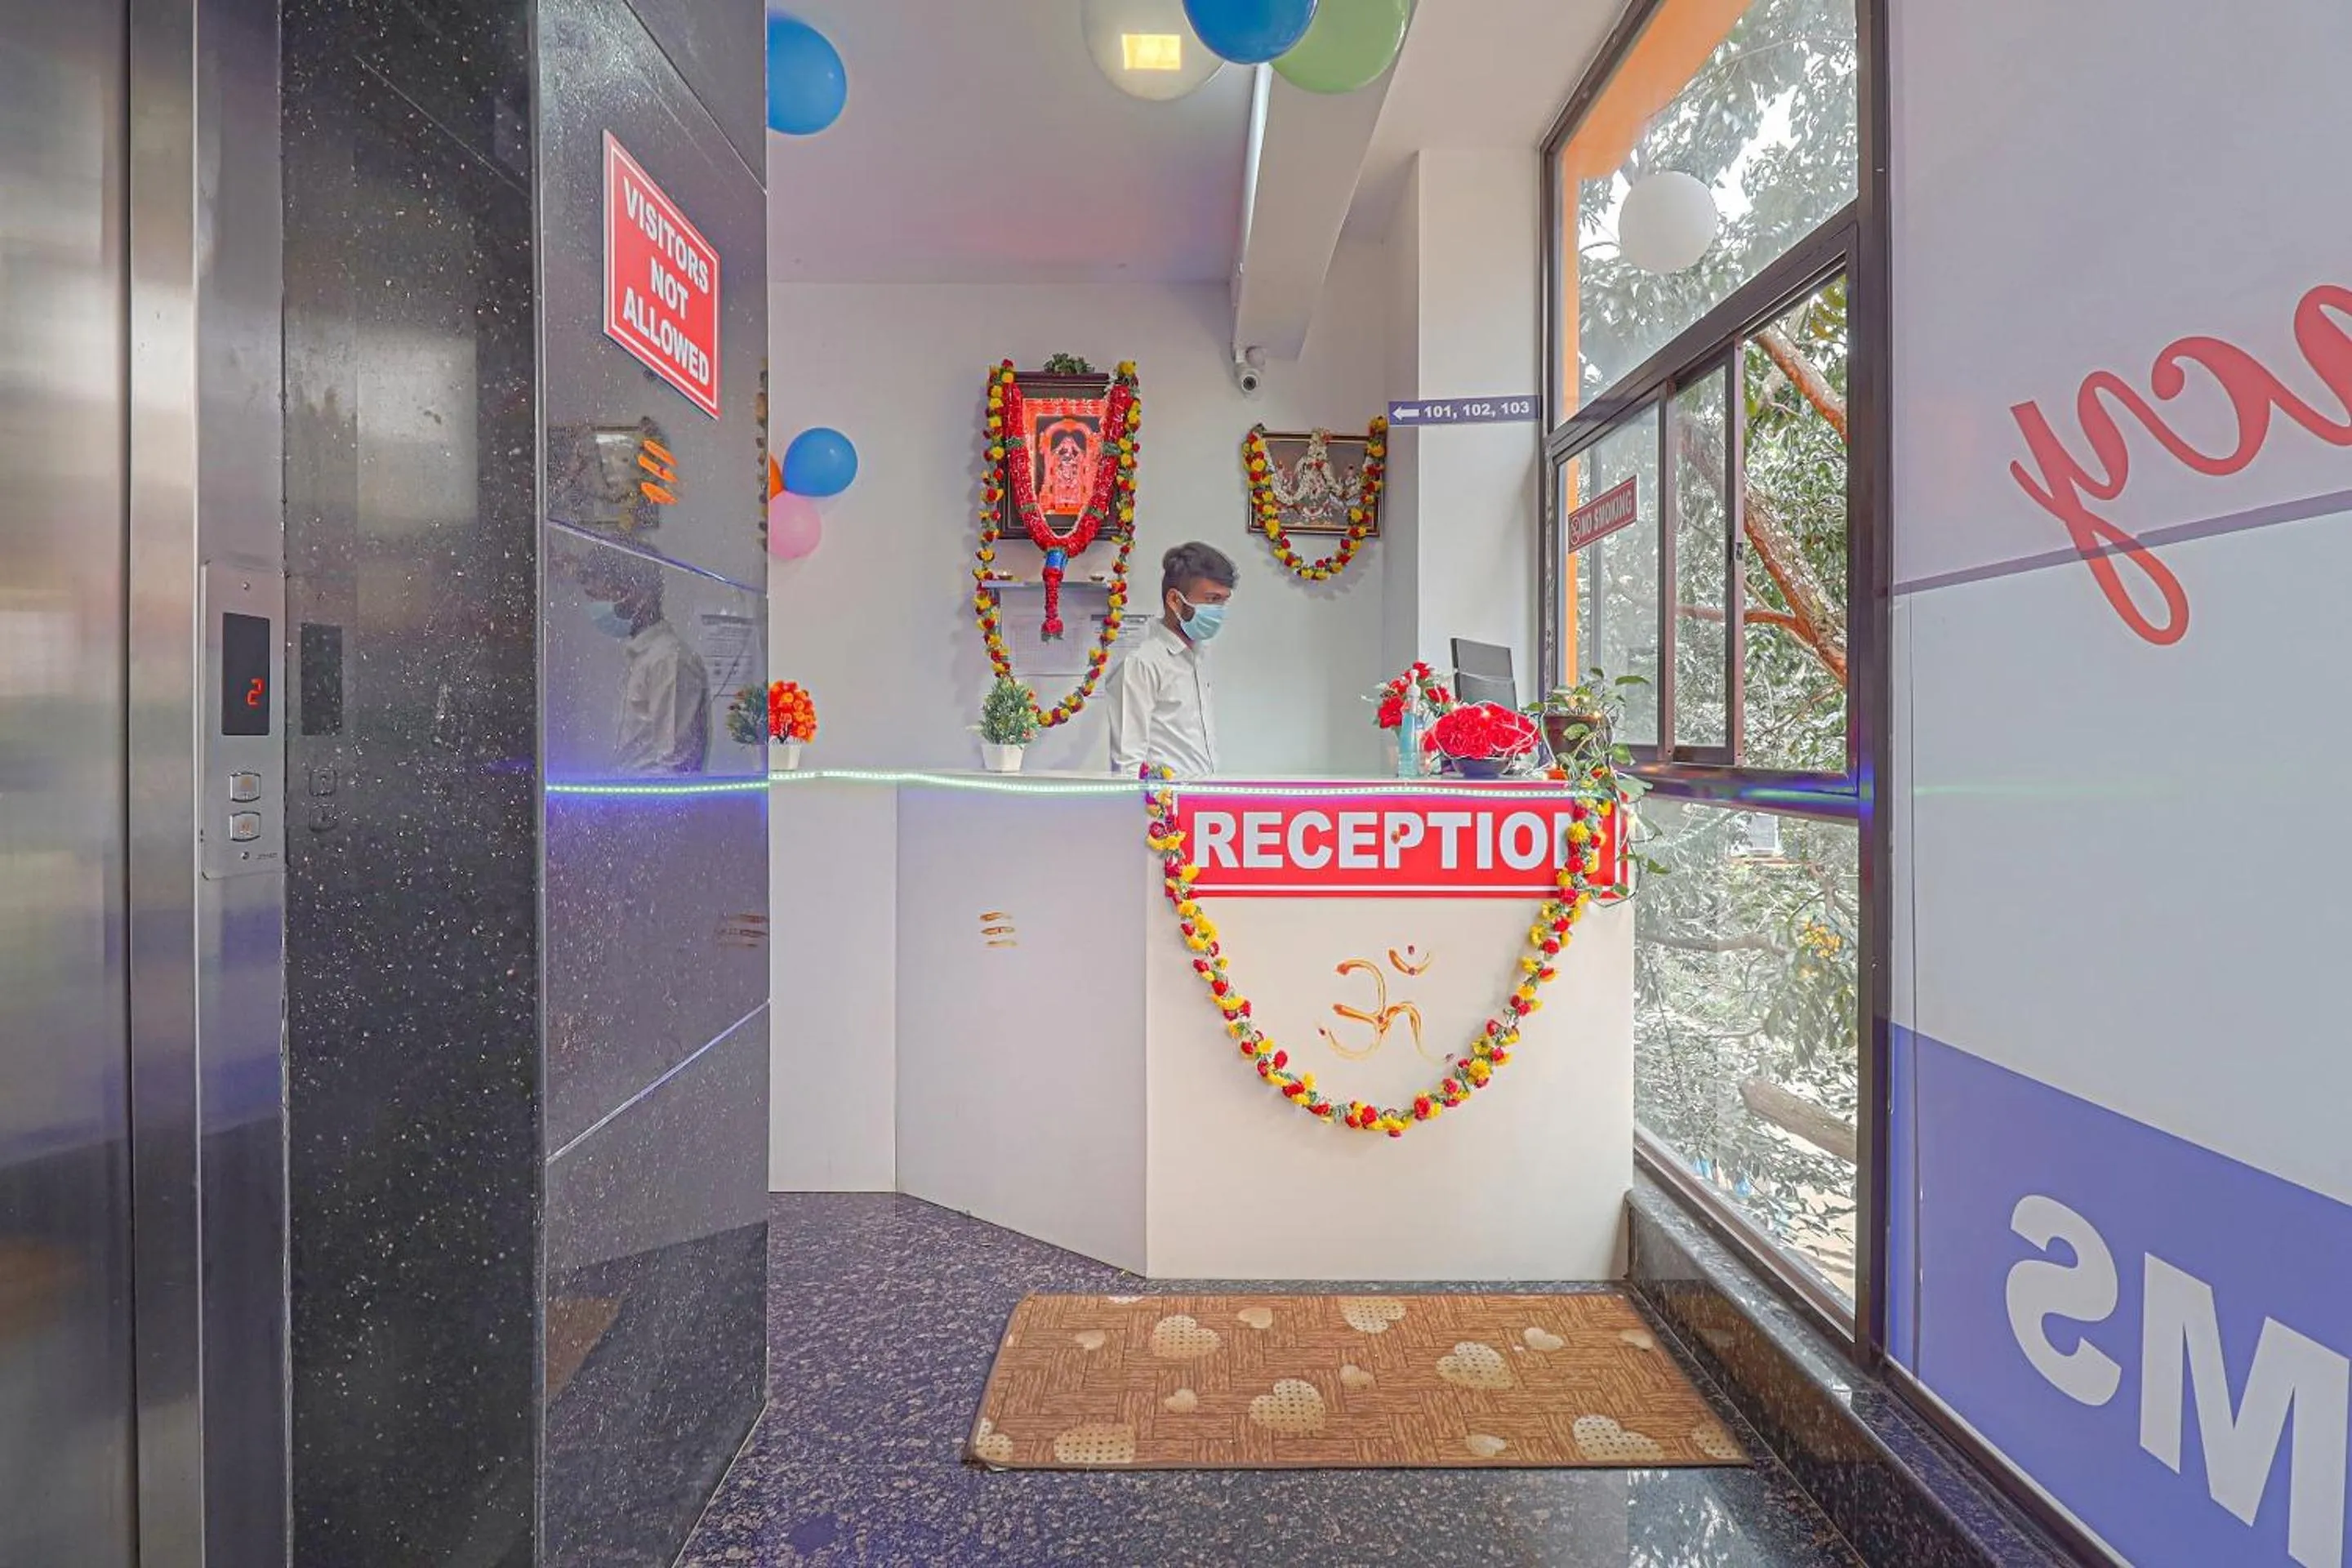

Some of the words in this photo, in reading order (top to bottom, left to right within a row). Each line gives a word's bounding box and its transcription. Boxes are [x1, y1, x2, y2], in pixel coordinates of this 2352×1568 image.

[623, 176, 709, 295] VISITORS
[650, 256, 688, 320] NOT
[623, 287, 710, 387] ALLOWED
[1423, 404, 1458, 420] 101,
[1463, 403, 1496, 417] 102,
[1501, 400, 1530, 414] 103
[1581, 511, 1592, 537] NO
[1594, 489, 1633, 532] SMOKING
[247, 678, 264, 708] 2
